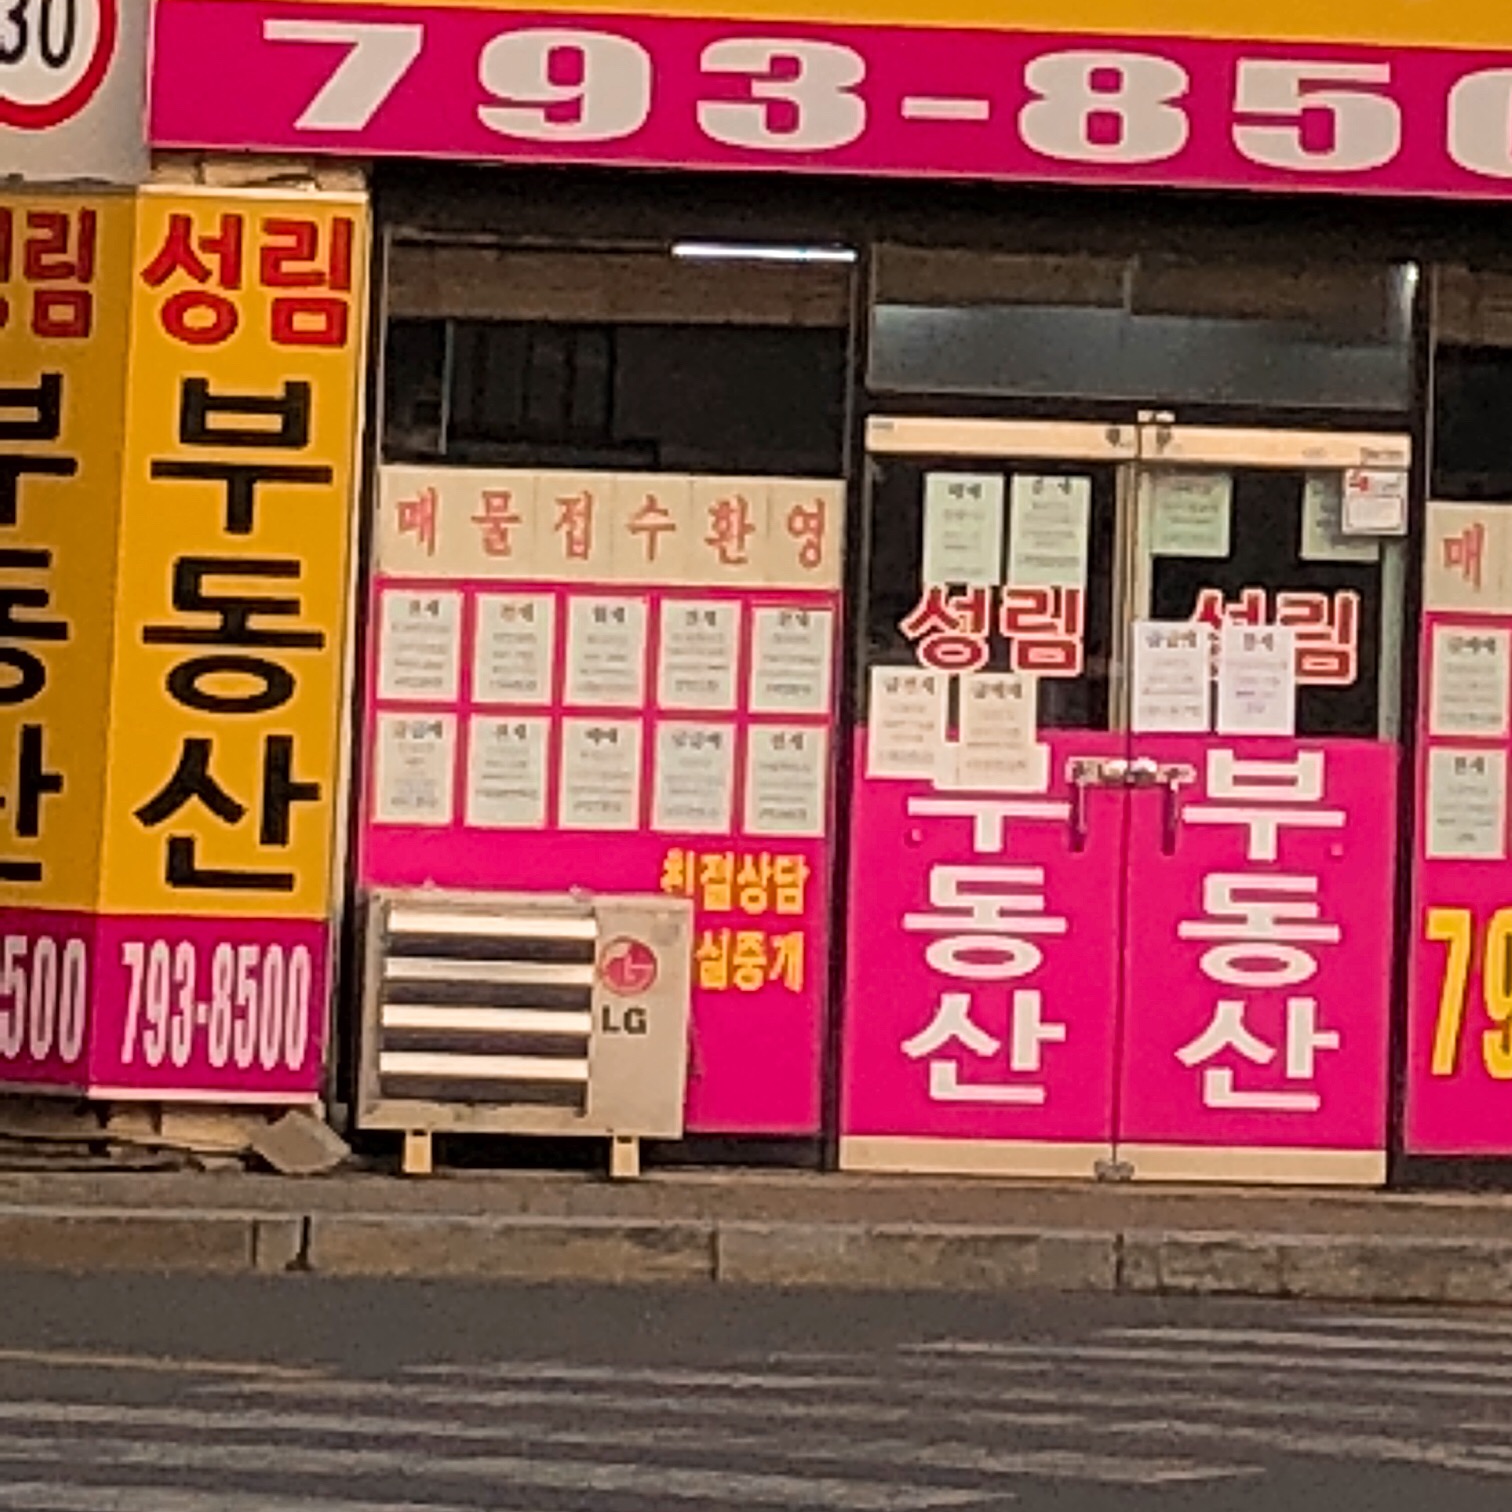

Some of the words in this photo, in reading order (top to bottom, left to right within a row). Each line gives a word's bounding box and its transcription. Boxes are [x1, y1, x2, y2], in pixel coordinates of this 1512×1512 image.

[0, 205, 96, 340] 림
[142, 211, 354, 348] 성림
[134, 374, 334, 894] 부동산
[900, 585, 1084, 677] 성림
[1174, 748, 1347, 1110] 부동산
[120, 940, 311, 1072] 793-8500
[601, 1006, 648, 1036] LG
